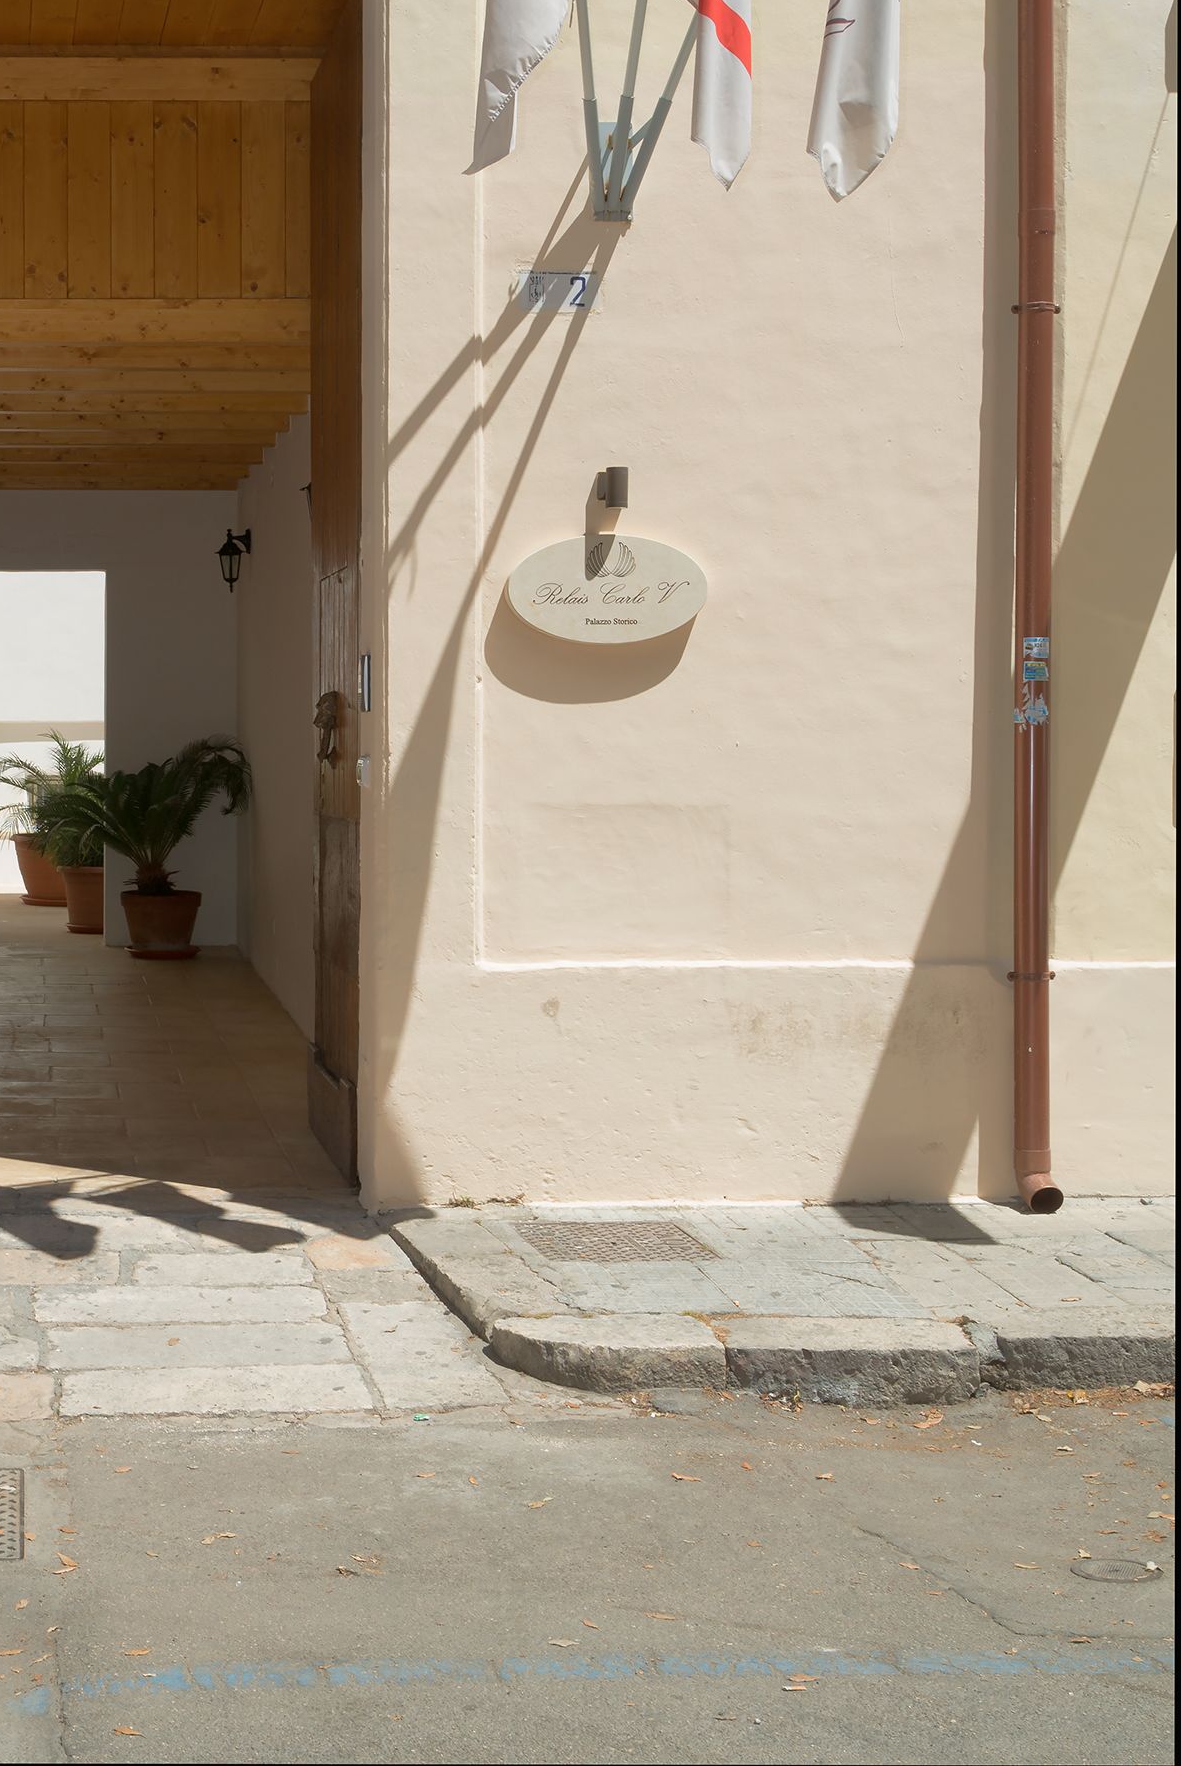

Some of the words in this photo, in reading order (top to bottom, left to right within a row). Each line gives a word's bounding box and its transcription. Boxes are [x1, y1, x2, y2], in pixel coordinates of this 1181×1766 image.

[570, 276, 586, 307] 2
[532, 582, 589, 605] Relais
[600, 582, 650, 605] Carlo
[657, 580, 690, 604] V
[585, 617, 612, 625] Palazzo
[613, 617, 638, 625] Storico
